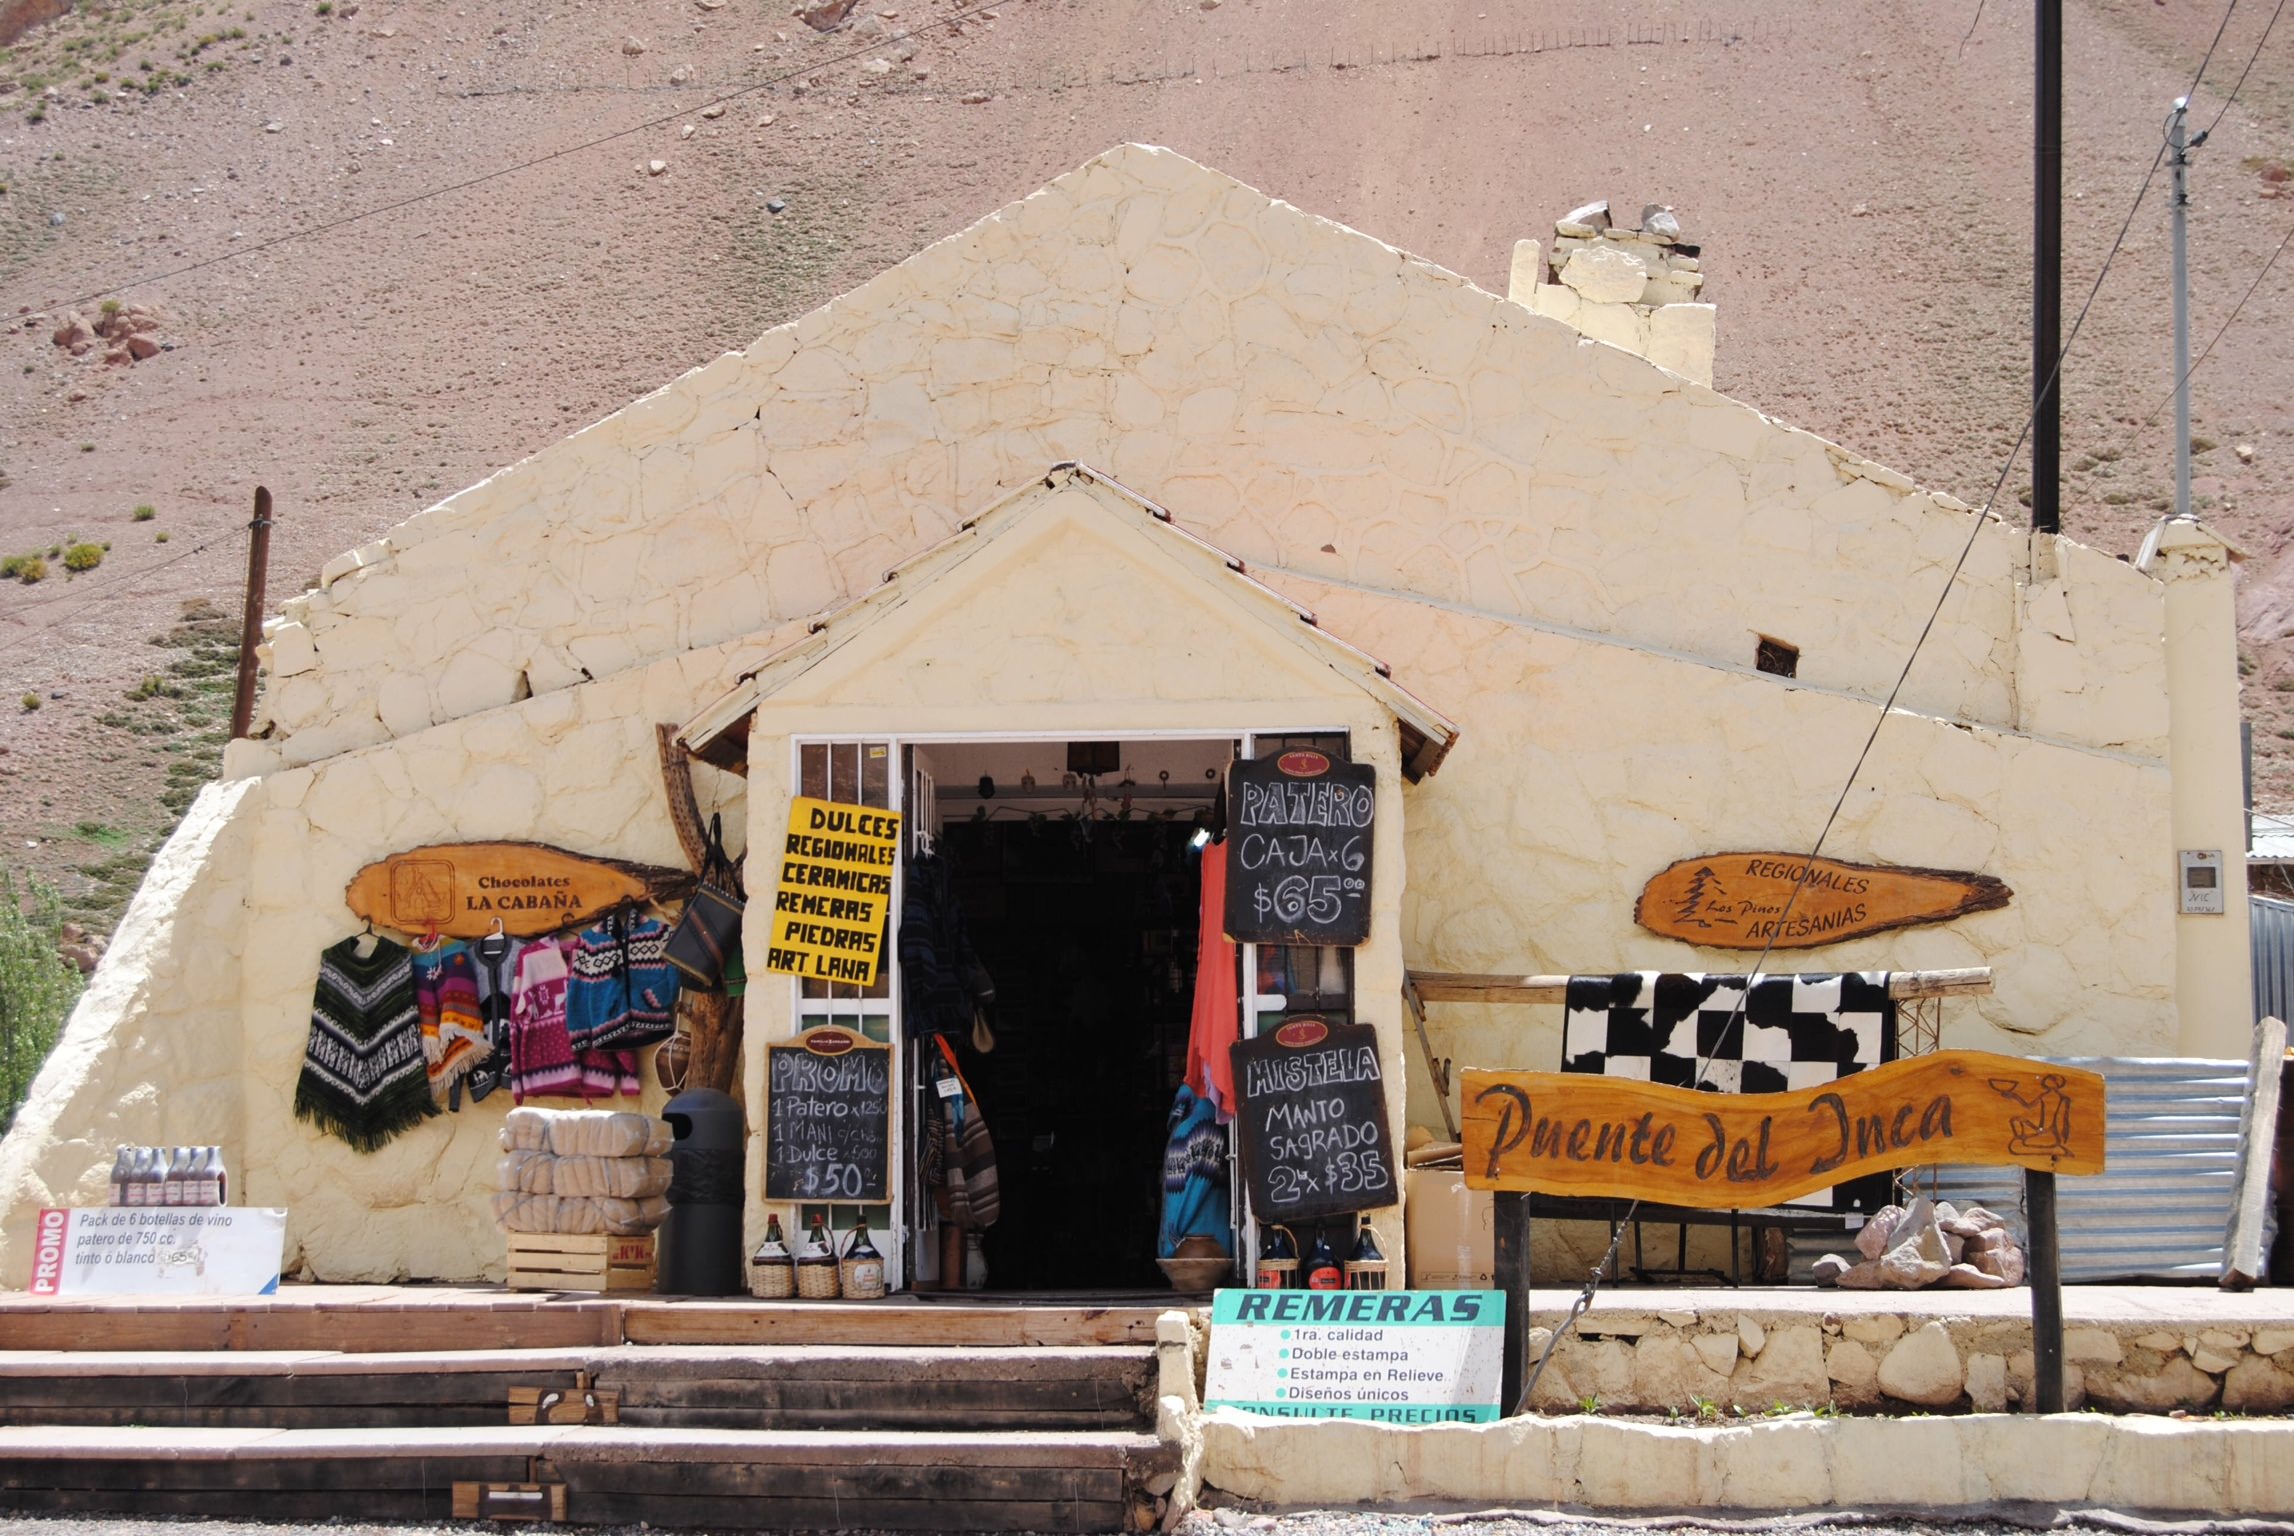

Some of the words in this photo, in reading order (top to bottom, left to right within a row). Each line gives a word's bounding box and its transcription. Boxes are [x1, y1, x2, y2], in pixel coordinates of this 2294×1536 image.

[1240, 781, 1375, 828] PATERO
[810, 808, 899, 840] DULCES
[786, 833, 896, 866] REGIONALES
[478, 875, 571, 889] Chocolates
[782, 862, 891, 895] CERAMICAS
[1746, 859, 1870, 895] REGIONALES
[466, 896, 493, 910] LA
[497, 890, 582, 910] CABAÑA
[776, 891, 874, 923] REMERAS
[1706, 900, 1732, 913] Los
[1738, 900, 1782, 916] Pinos
[1746, 903, 1867, 939] ARTESANIAS
[784, 922, 877, 953] PIEDRAS
[767, 948, 810, 974] ART
[815, 955, 871, 981] LANA
[771, 1053, 886, 1094] PROMO
[1247, 1046, 1381, 1098] MISTELA
[772, 1098, 784, 1117] 1
[786, 1096, 849, 1118] Patero
[1265, 1098, 1345, 1132] MANTO
[773, 1123, 784, 1142] 1
[1474, 1083, 1677, 1179] Puente
[1696, 1111, 1779, 1183] del
[1808, 1091, 1953, 1175] Inca
[786, 1144, 838, 1163] Dulce
[80, 1213, 108, 1227] Pack
[111, 1213, 126, 1226] de
[129, 1213, 136, 1225] 6
[139, 1212, 185, 1226] botellas
[188, 1213, 203, 1226] de
[207, 1214, 232, 1226] vino
[35, 1211, 64, 1292] PROMO
[77, 1233, 115, 1248] patero
[118, 1232, 132, 1245] de
[135, 1231, 156, 1245] 750
[75, 1251, 100, 1265] tinto
[115, 1250, 156, 1265] blanco
[1236, 1293, 1483, 1322] REMERAS
[1294, 1329, 1322, 1342] 1ra.
[1327, 1328, 1384, 1342] calidad
[1291, 1347, 1337, 1361] Doble
[1342, 1349, 1409, 1363] estampa
[1290, 1367, 1358, 1382] Estampa
[1363, 1371, 1382, 1382] en
[1387, 1367, 1444, 1382] Relieve
[1288, 1385, 1352, 1401] Diseños
[1357, 1385, 1409, 1401] únicos
